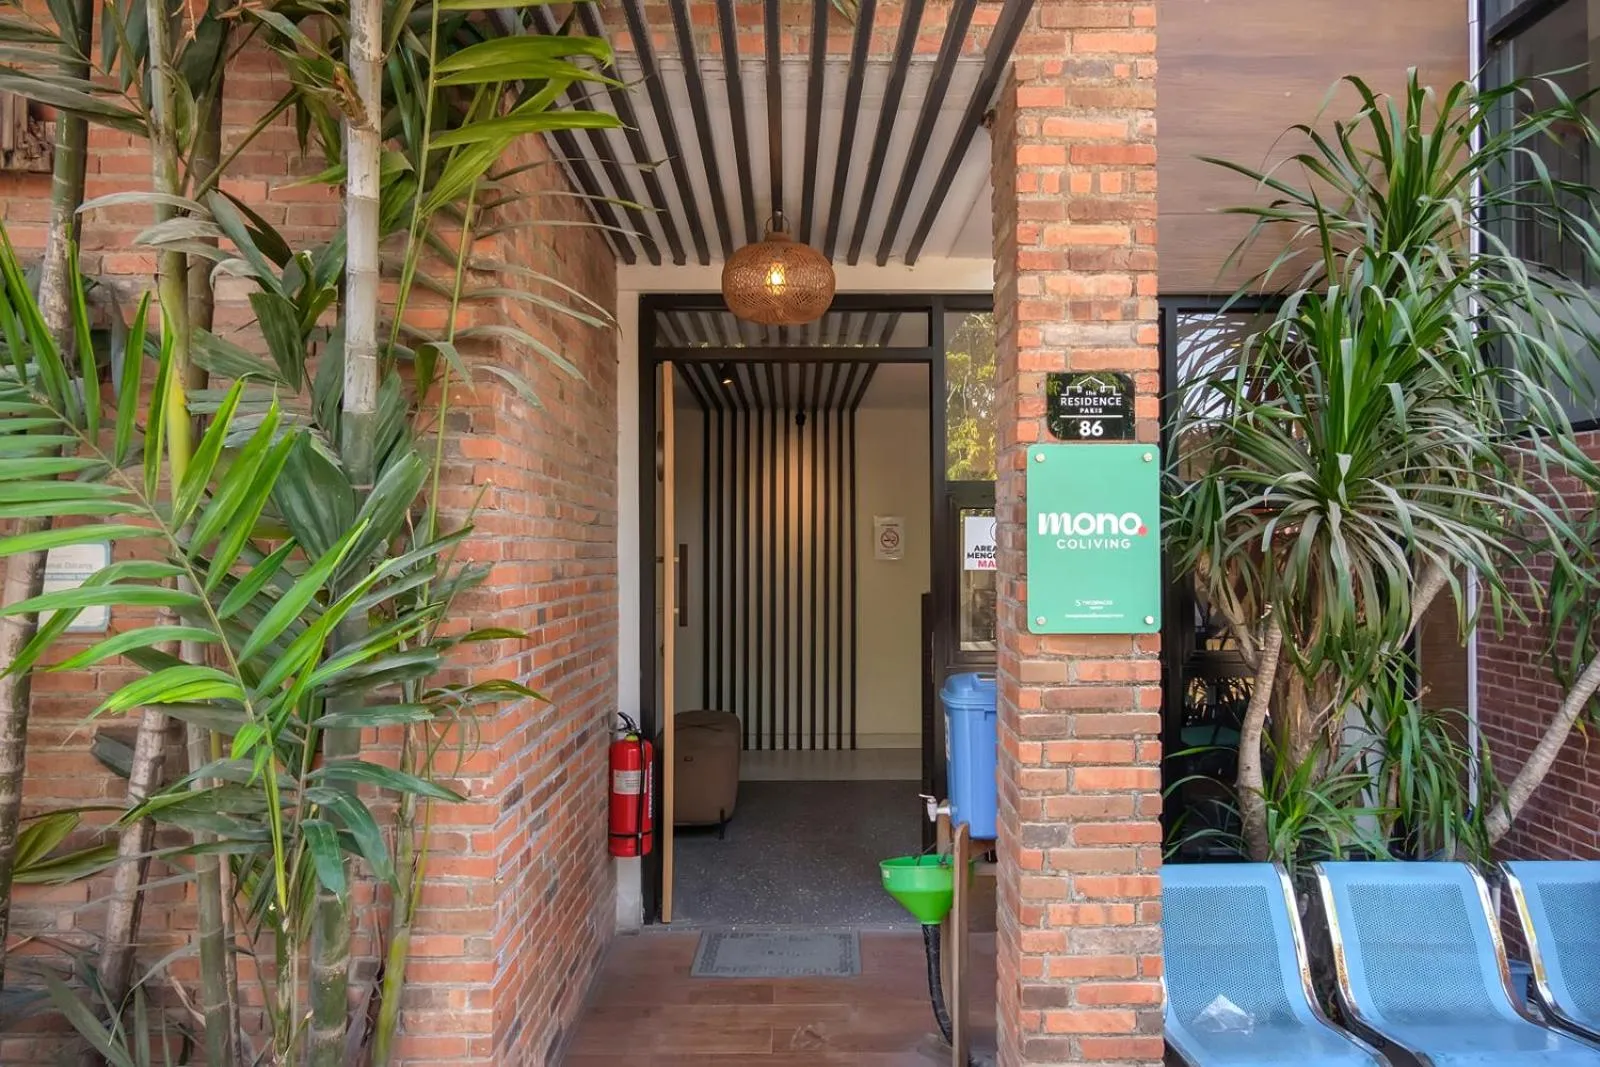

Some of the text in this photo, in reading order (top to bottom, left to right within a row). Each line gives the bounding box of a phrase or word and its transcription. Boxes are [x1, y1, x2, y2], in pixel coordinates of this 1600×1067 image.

[1060, 397, 1122, 406] RESIDENCE
[1080, 420, 1103, 436] 86
[1056, 538, 1131, 549] COLIVING
